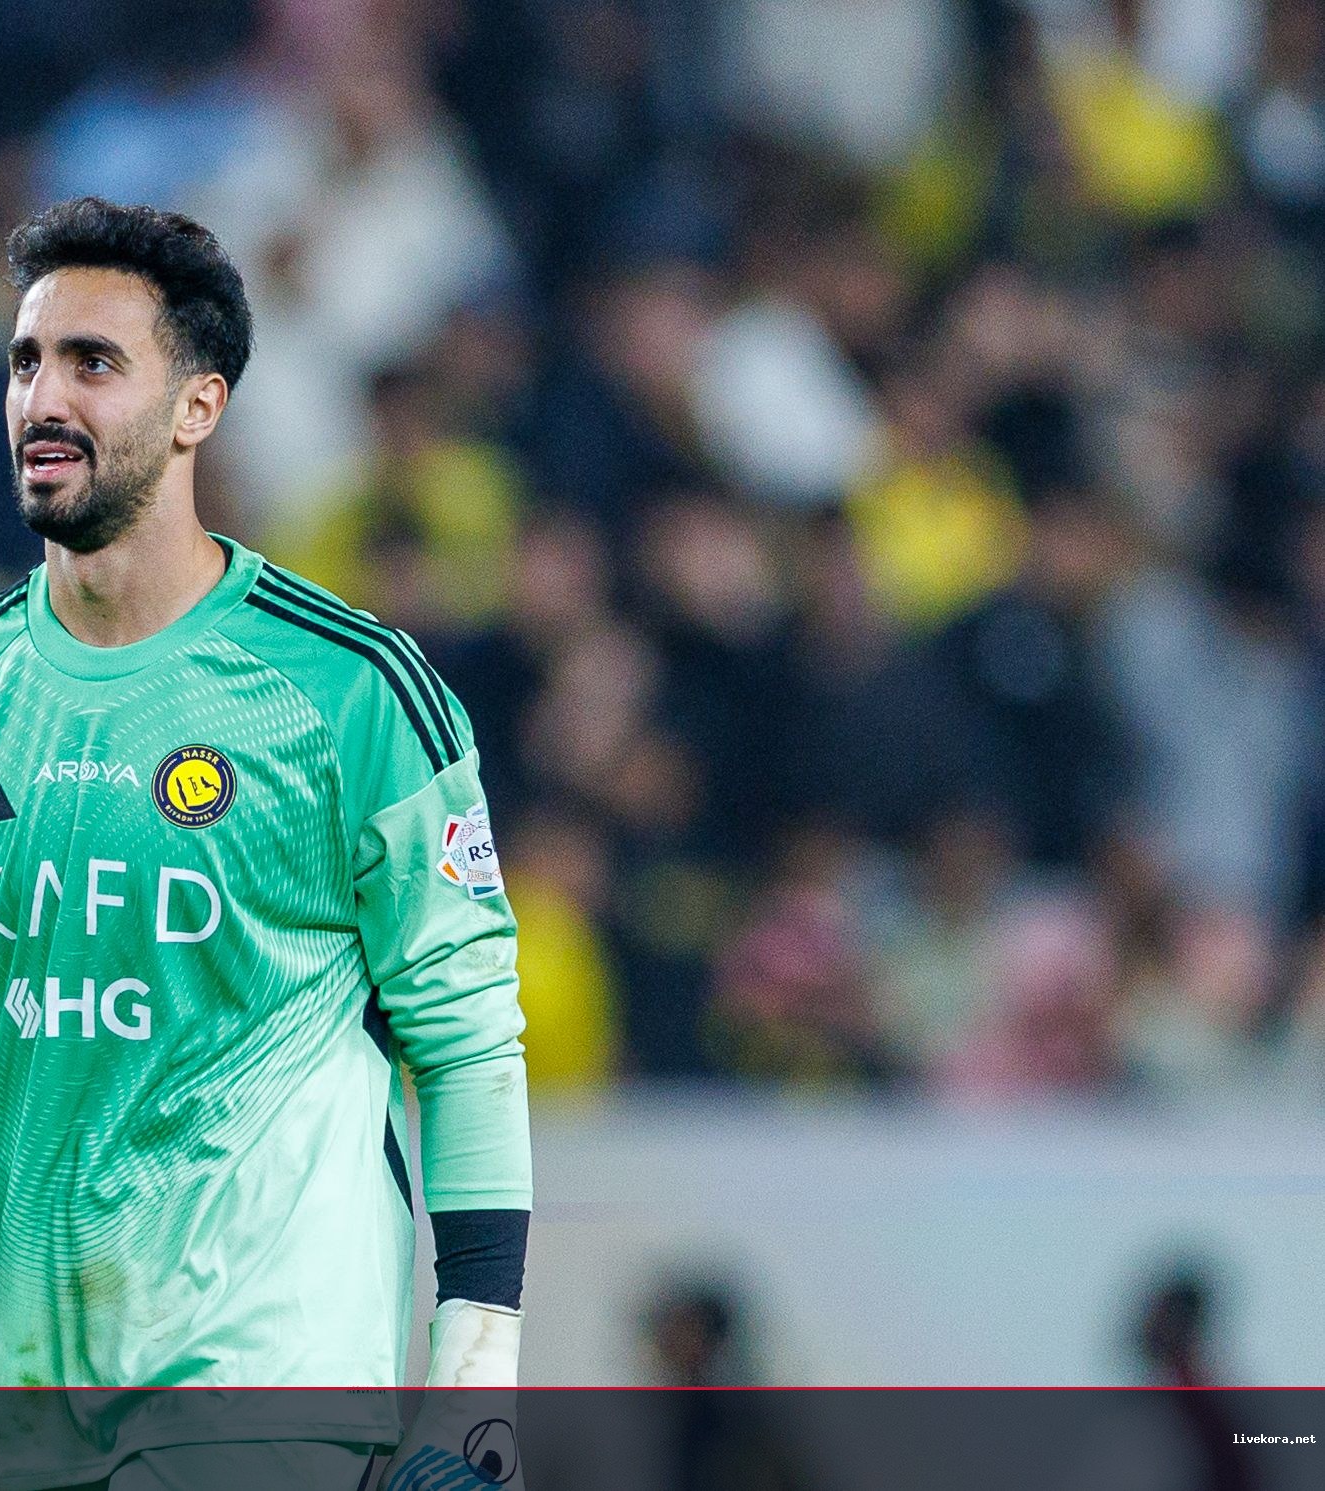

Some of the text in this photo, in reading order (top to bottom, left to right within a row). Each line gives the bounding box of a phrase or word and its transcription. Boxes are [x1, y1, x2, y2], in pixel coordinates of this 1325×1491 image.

[182, 750, 220, 764] NASSR
[33, 761, 141, 788] AROYA
[468, 838, 495, 861] RS
